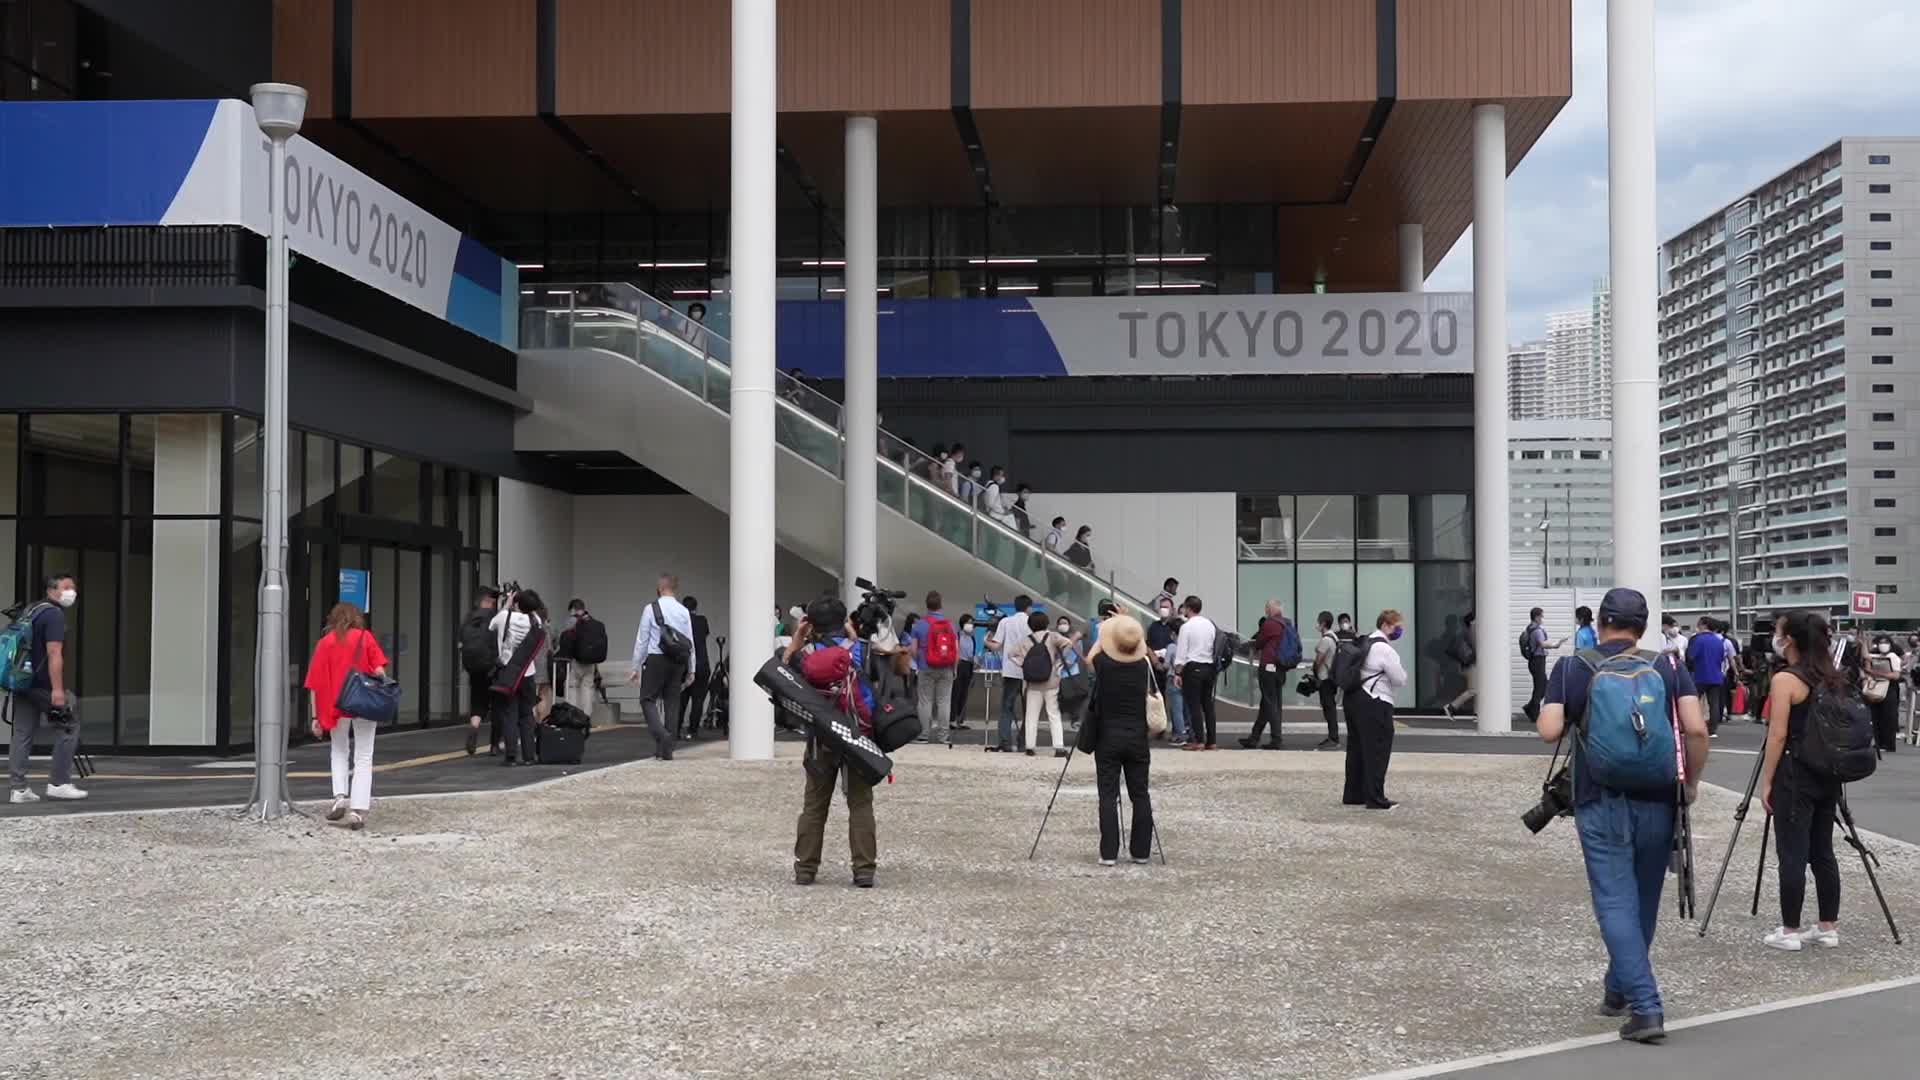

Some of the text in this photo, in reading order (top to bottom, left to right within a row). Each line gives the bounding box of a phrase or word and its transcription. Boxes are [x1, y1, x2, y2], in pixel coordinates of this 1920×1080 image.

[369, 203, 427, 288] 2020
[1118, 308, 1457, 359] TOKYO 2020
